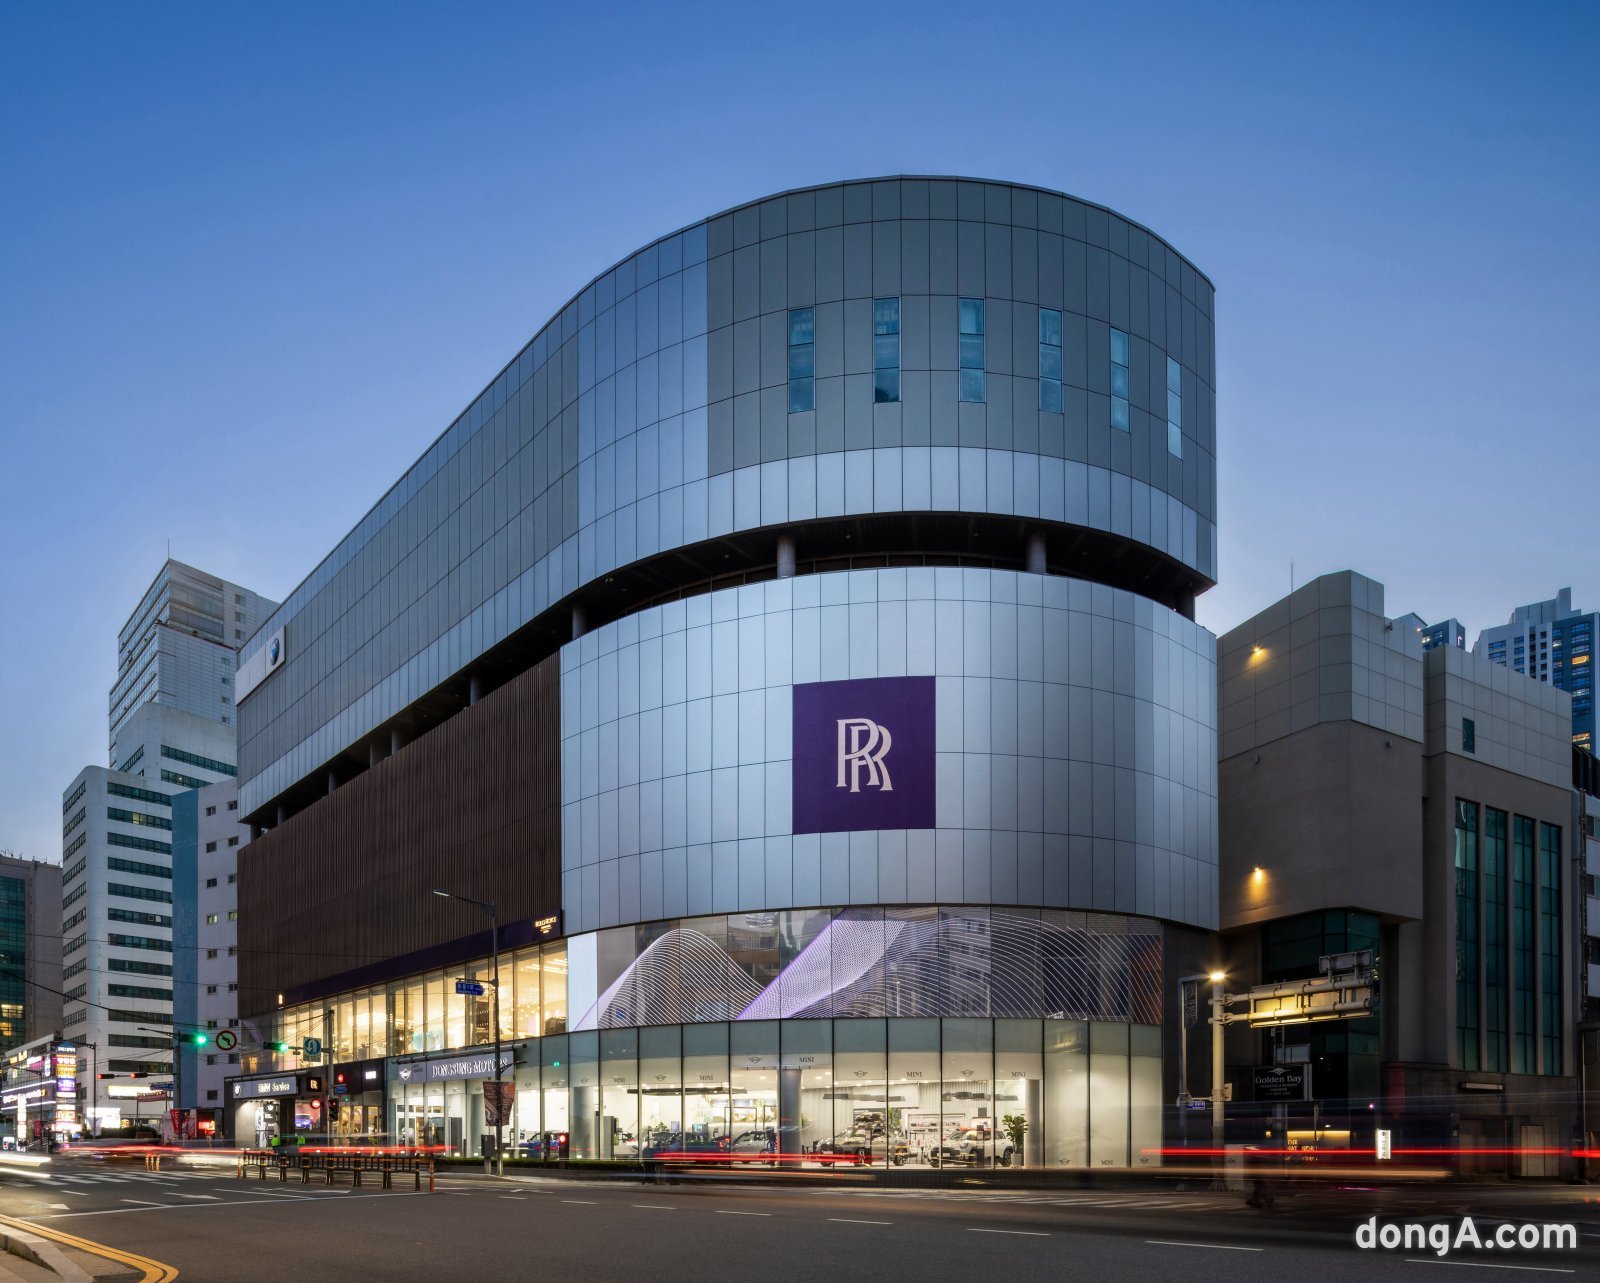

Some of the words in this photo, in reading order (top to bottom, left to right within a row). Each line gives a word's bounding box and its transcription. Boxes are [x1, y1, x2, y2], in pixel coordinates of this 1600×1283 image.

[431, 1063, 472, 1078] DONGSUNG
[1255, 1076, 1285, 1084] Golden
[1286, 1074, 1303, 1084] Bay
